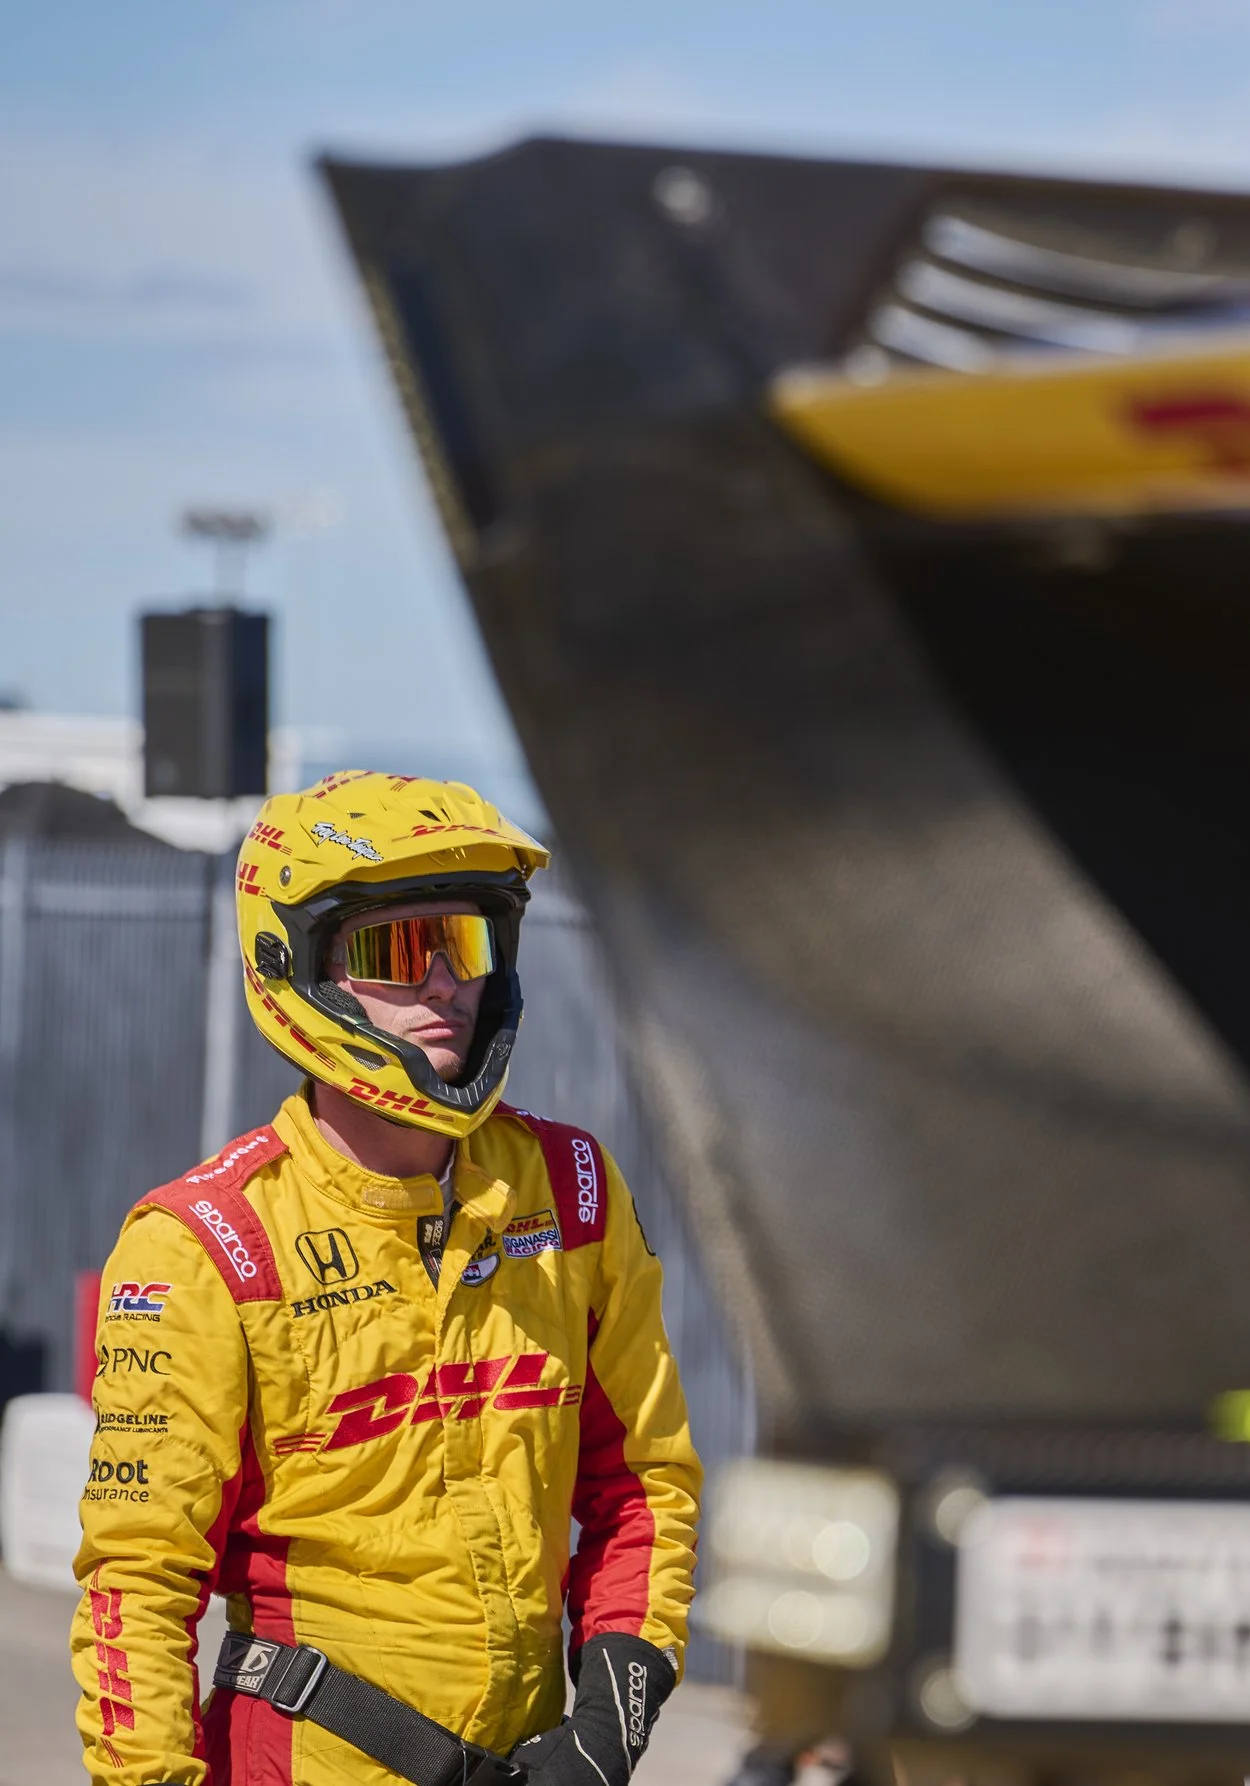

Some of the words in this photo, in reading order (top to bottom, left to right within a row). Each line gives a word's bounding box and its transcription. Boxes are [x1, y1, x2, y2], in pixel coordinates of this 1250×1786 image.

[347, 1077, 437, 1117] DHL
[571, 1139, 598, 1225] sparco
[189, 1200, 257, 1283] sparco
[292, 1279, 398, 1319] HONDA
[112, 1348, 172, 1376] PNC
[325, 1353, 564, 1451] DHL
[90, 1587, 135, 1736] DHL
[628, 1661, 648, 1749] sparco
